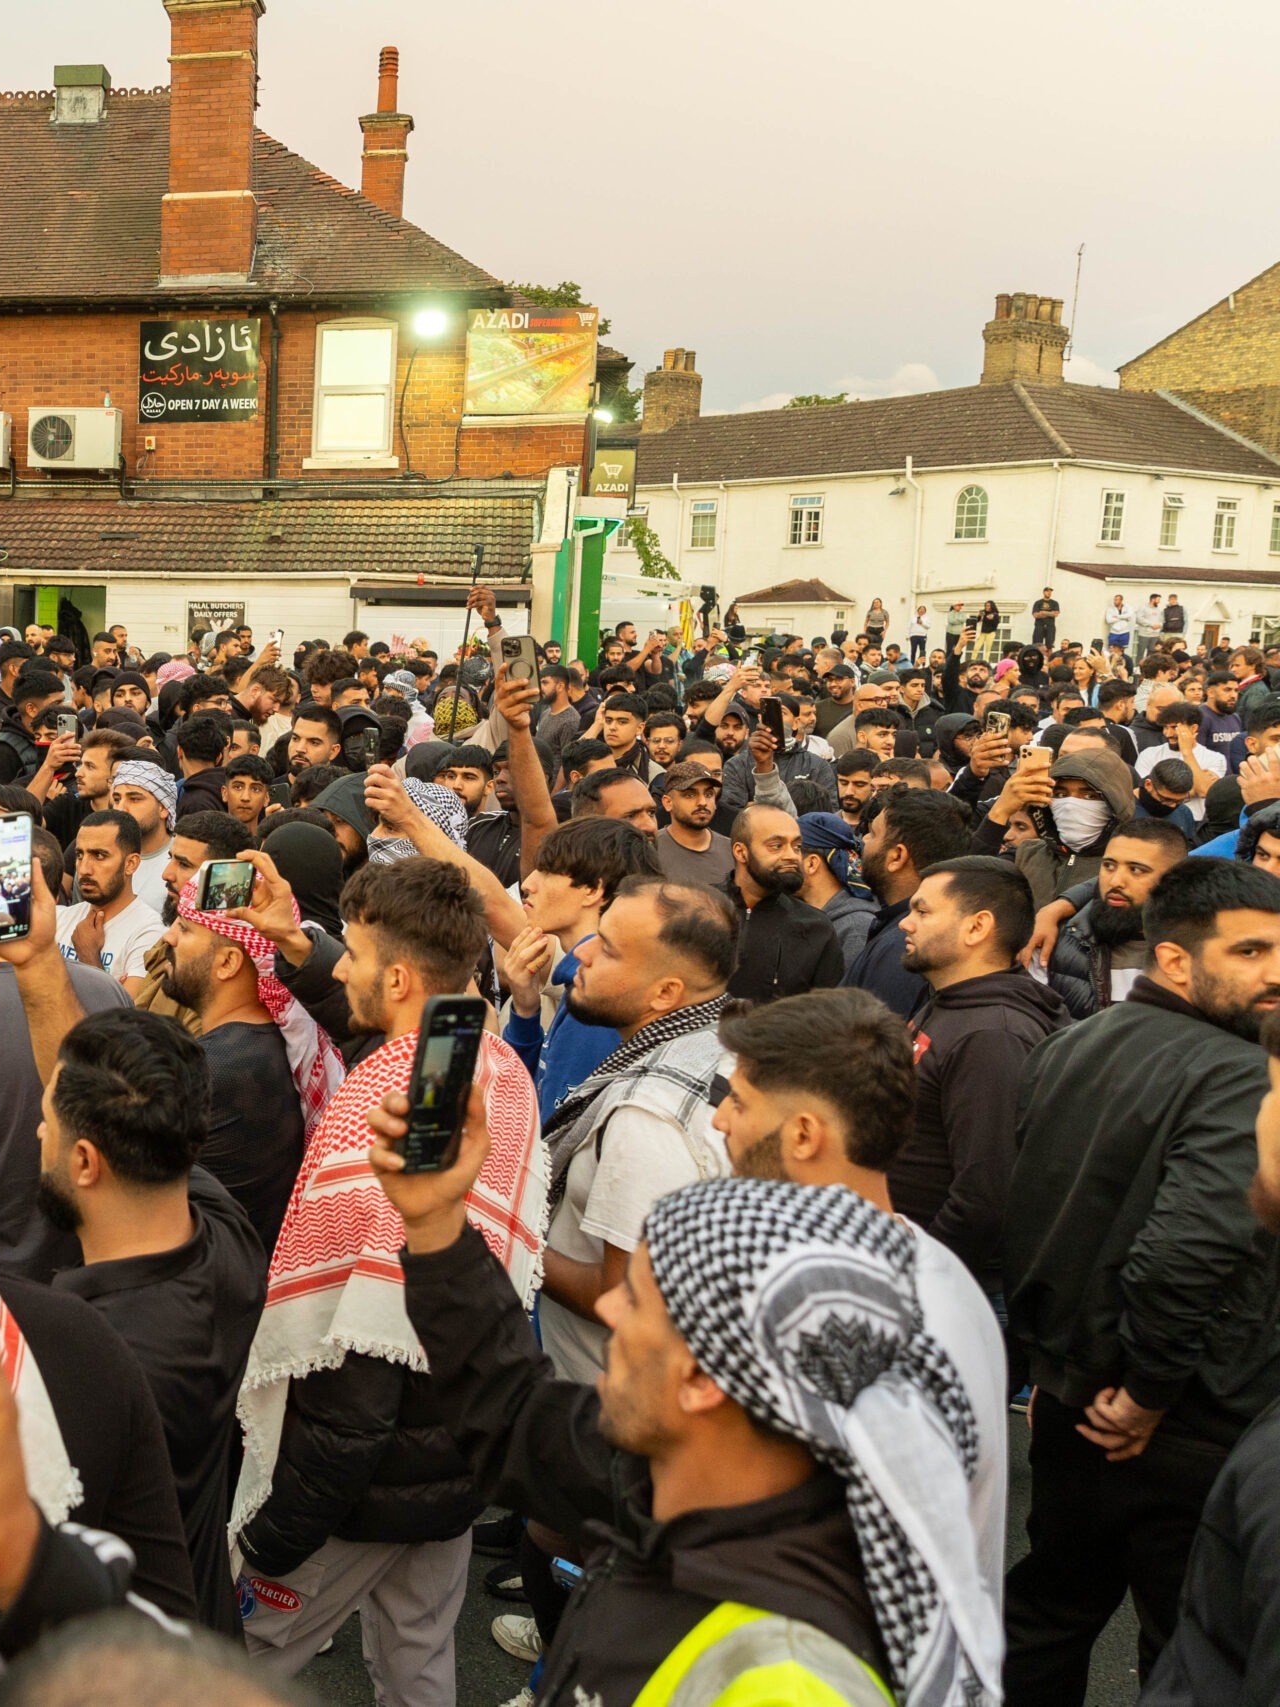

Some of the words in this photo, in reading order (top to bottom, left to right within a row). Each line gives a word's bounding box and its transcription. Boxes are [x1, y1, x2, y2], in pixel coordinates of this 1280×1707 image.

[473, 312, 529, 329] AZADI
[144, 323, 253, 362] ئازادی
[167, 399, 193, 411] OPEN
[194, 399, 201, 410] 7
[201, 398, 220, 410] DAY
[221, 398, 229, 410] A
[230, 398, 256, 410] WEEK
[594, 483, 629, 492] AZADI
[253, 1581, 296, 1608] MERCIER
